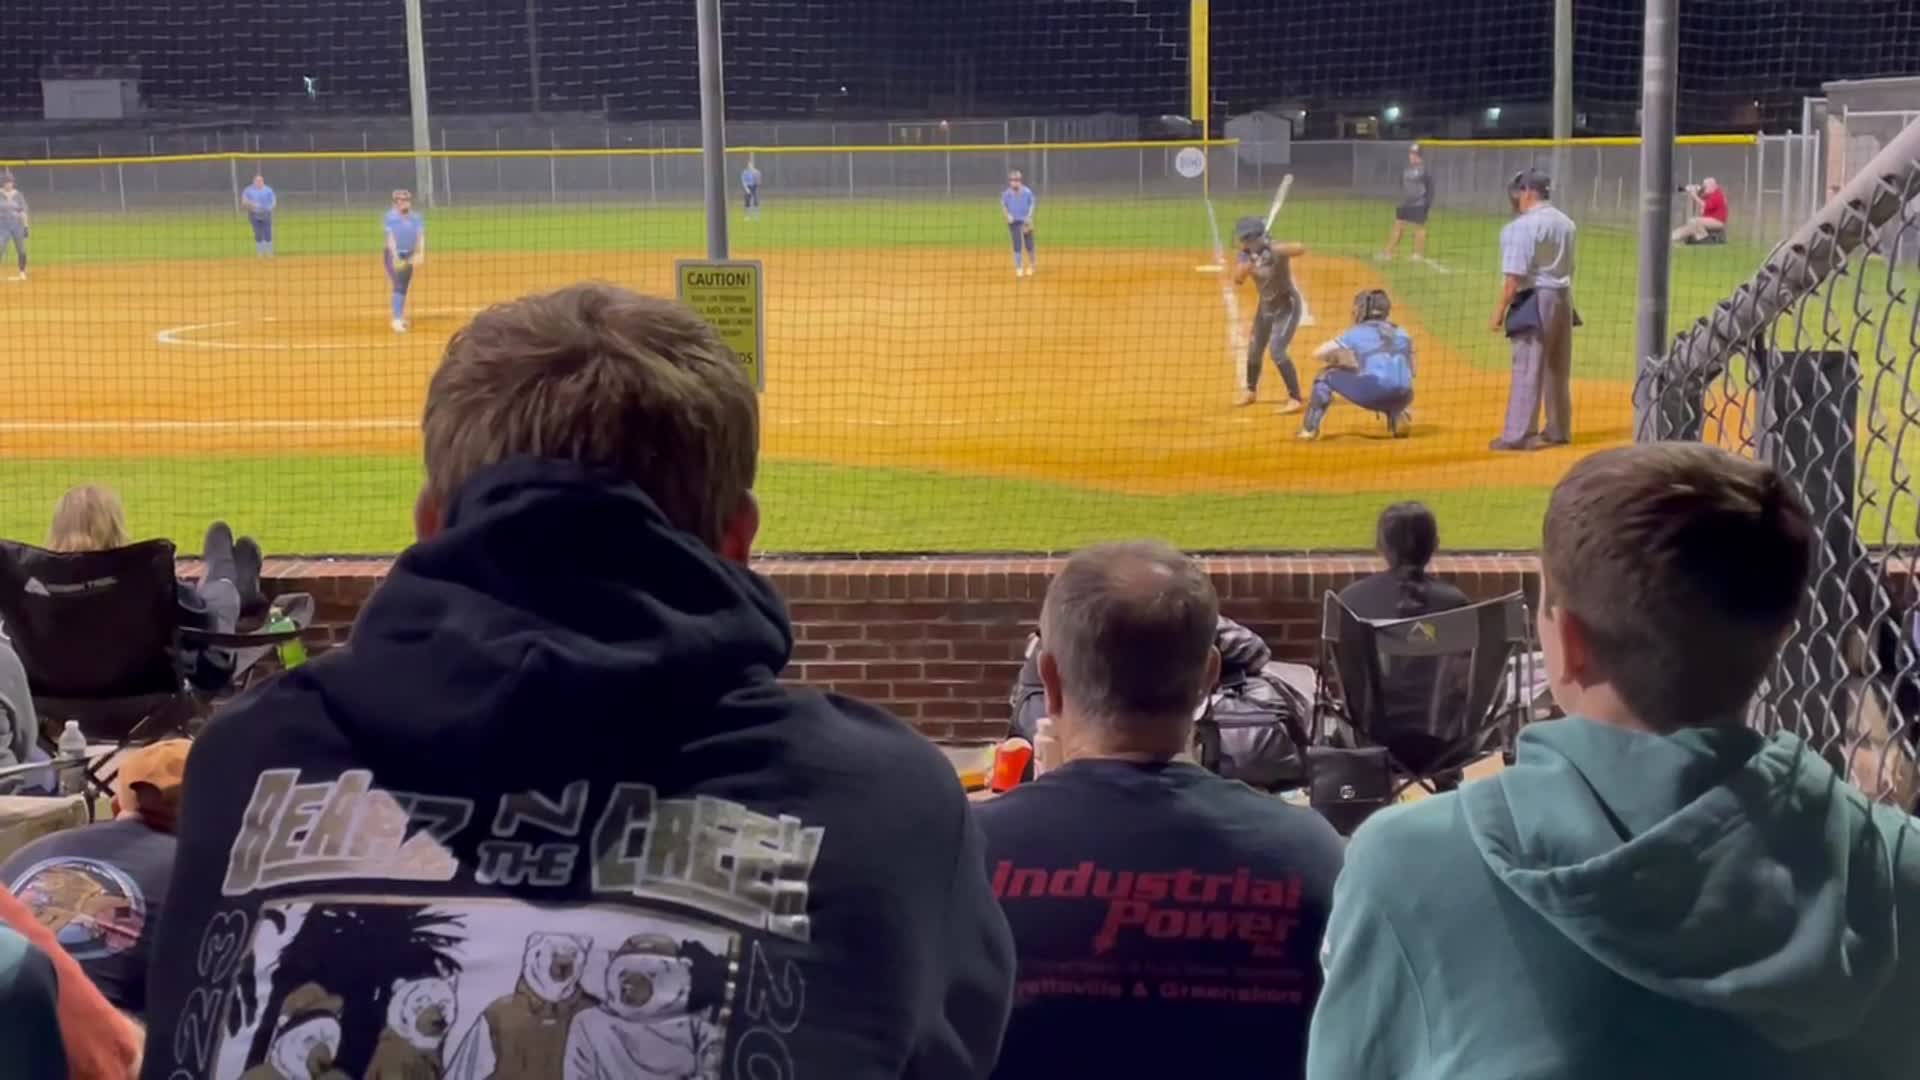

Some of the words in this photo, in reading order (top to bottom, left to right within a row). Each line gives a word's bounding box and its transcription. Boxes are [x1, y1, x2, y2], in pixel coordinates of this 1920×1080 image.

[687, 272, 751, 286] CAUTION!
[491, 780, 590, 838] N
[475, 840, 580, 886] THE
[991, 860, 1303, 910] Industrial
[1092, 900, 1298, 955] Power
